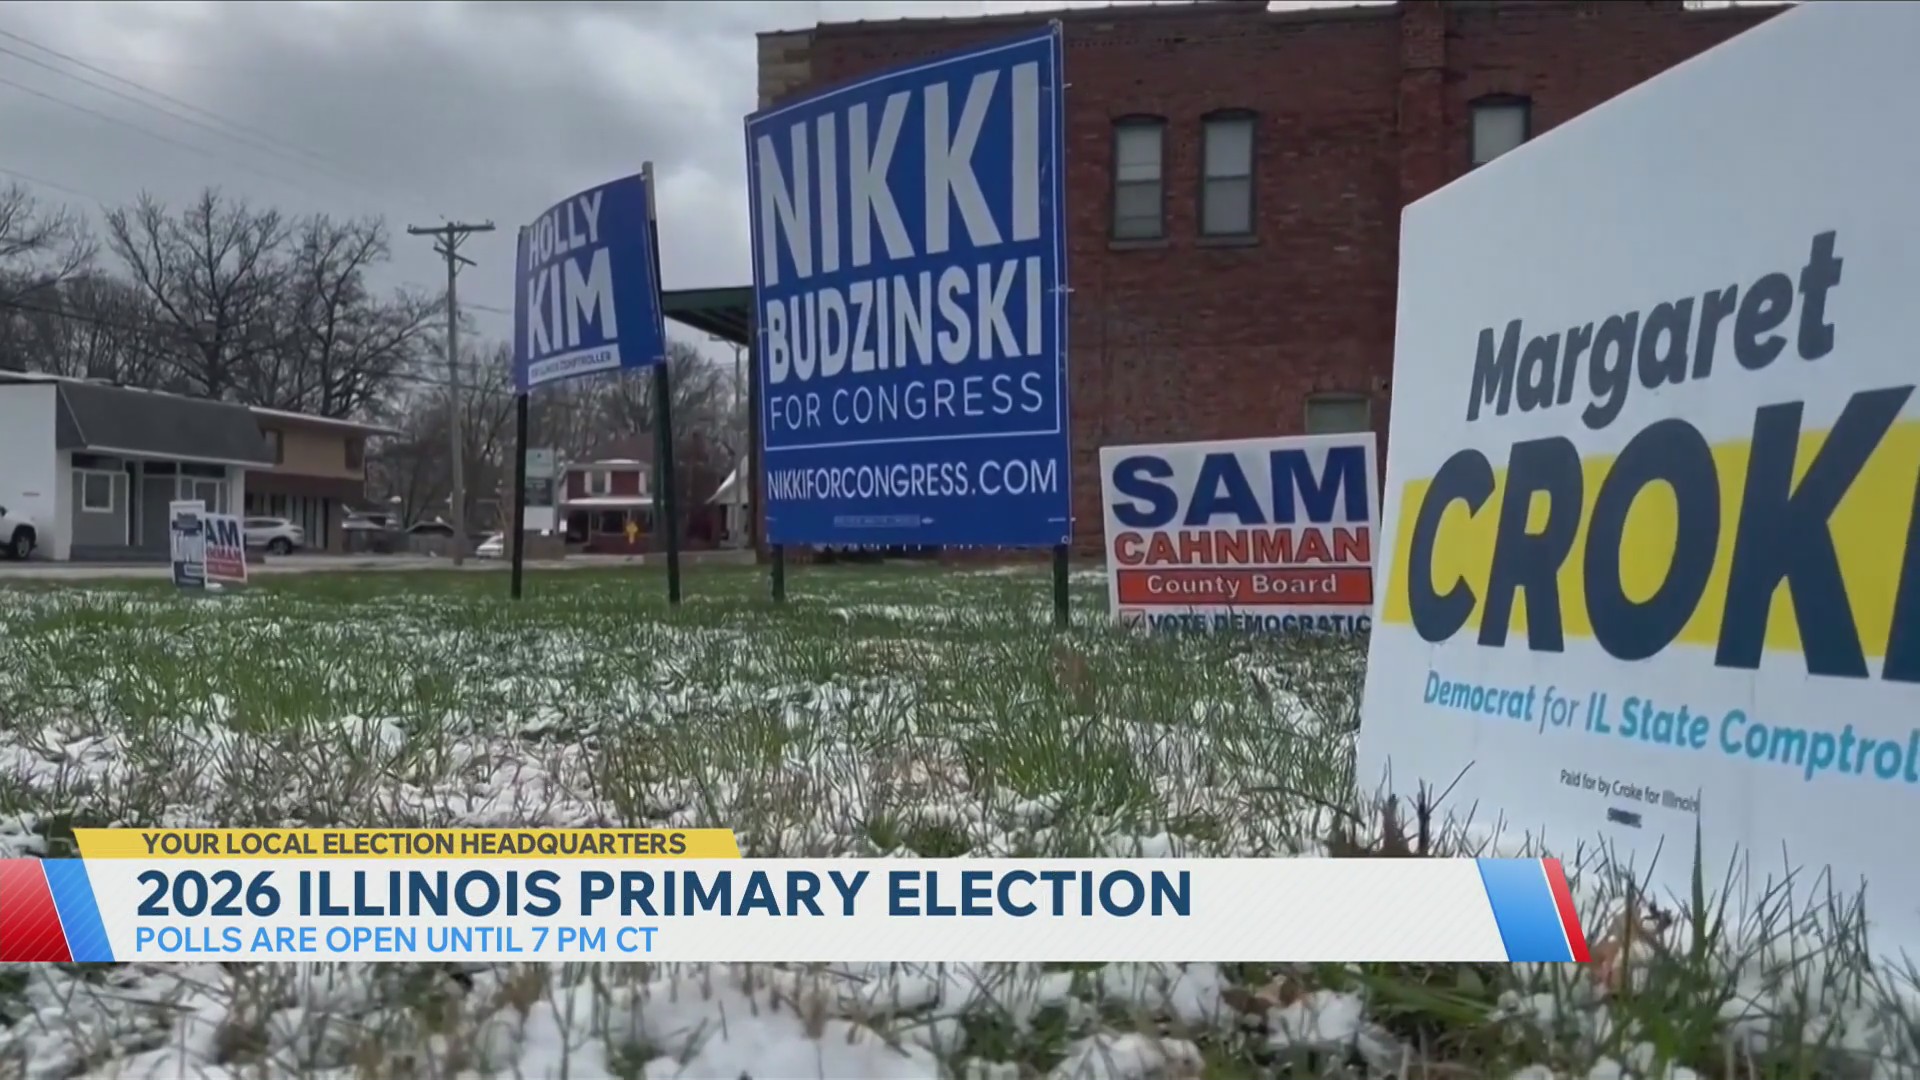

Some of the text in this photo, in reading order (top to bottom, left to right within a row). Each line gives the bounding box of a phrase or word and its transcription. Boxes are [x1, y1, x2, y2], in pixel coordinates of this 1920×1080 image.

[757, 60, 1040, 288] NIKKI
[528, 189, 603, 272] HOLLY
[528, 246, 618, 360] KIM
[766, 256, 1043, 384] BUDZINSKI
[1466, 230, 1843, 430] Margaret
[770, 371, 1043, 431] FOR CONGRESS
[767, 458, 1058, 500] NIKKIFORCONGRESS.COM
[1112, 445, 1369, 528] SAM
[206, 519, 240, 548] AM
[1114, 526, 1371, 566] CAHNMAN
[1408, 383, 1920, 684] CROK
[1147, 573, 1337, 599] County Board
[1148, 613, 1372, 634] VOTE DEMOCRATIC
[1423, 669, 1920, 784] Democrat for IL State Comptrol
[1560, 769, 1581, 787] Paid
[1598, 776, 1610, 798] by
[1612, 779, 1643, 801] Croke
